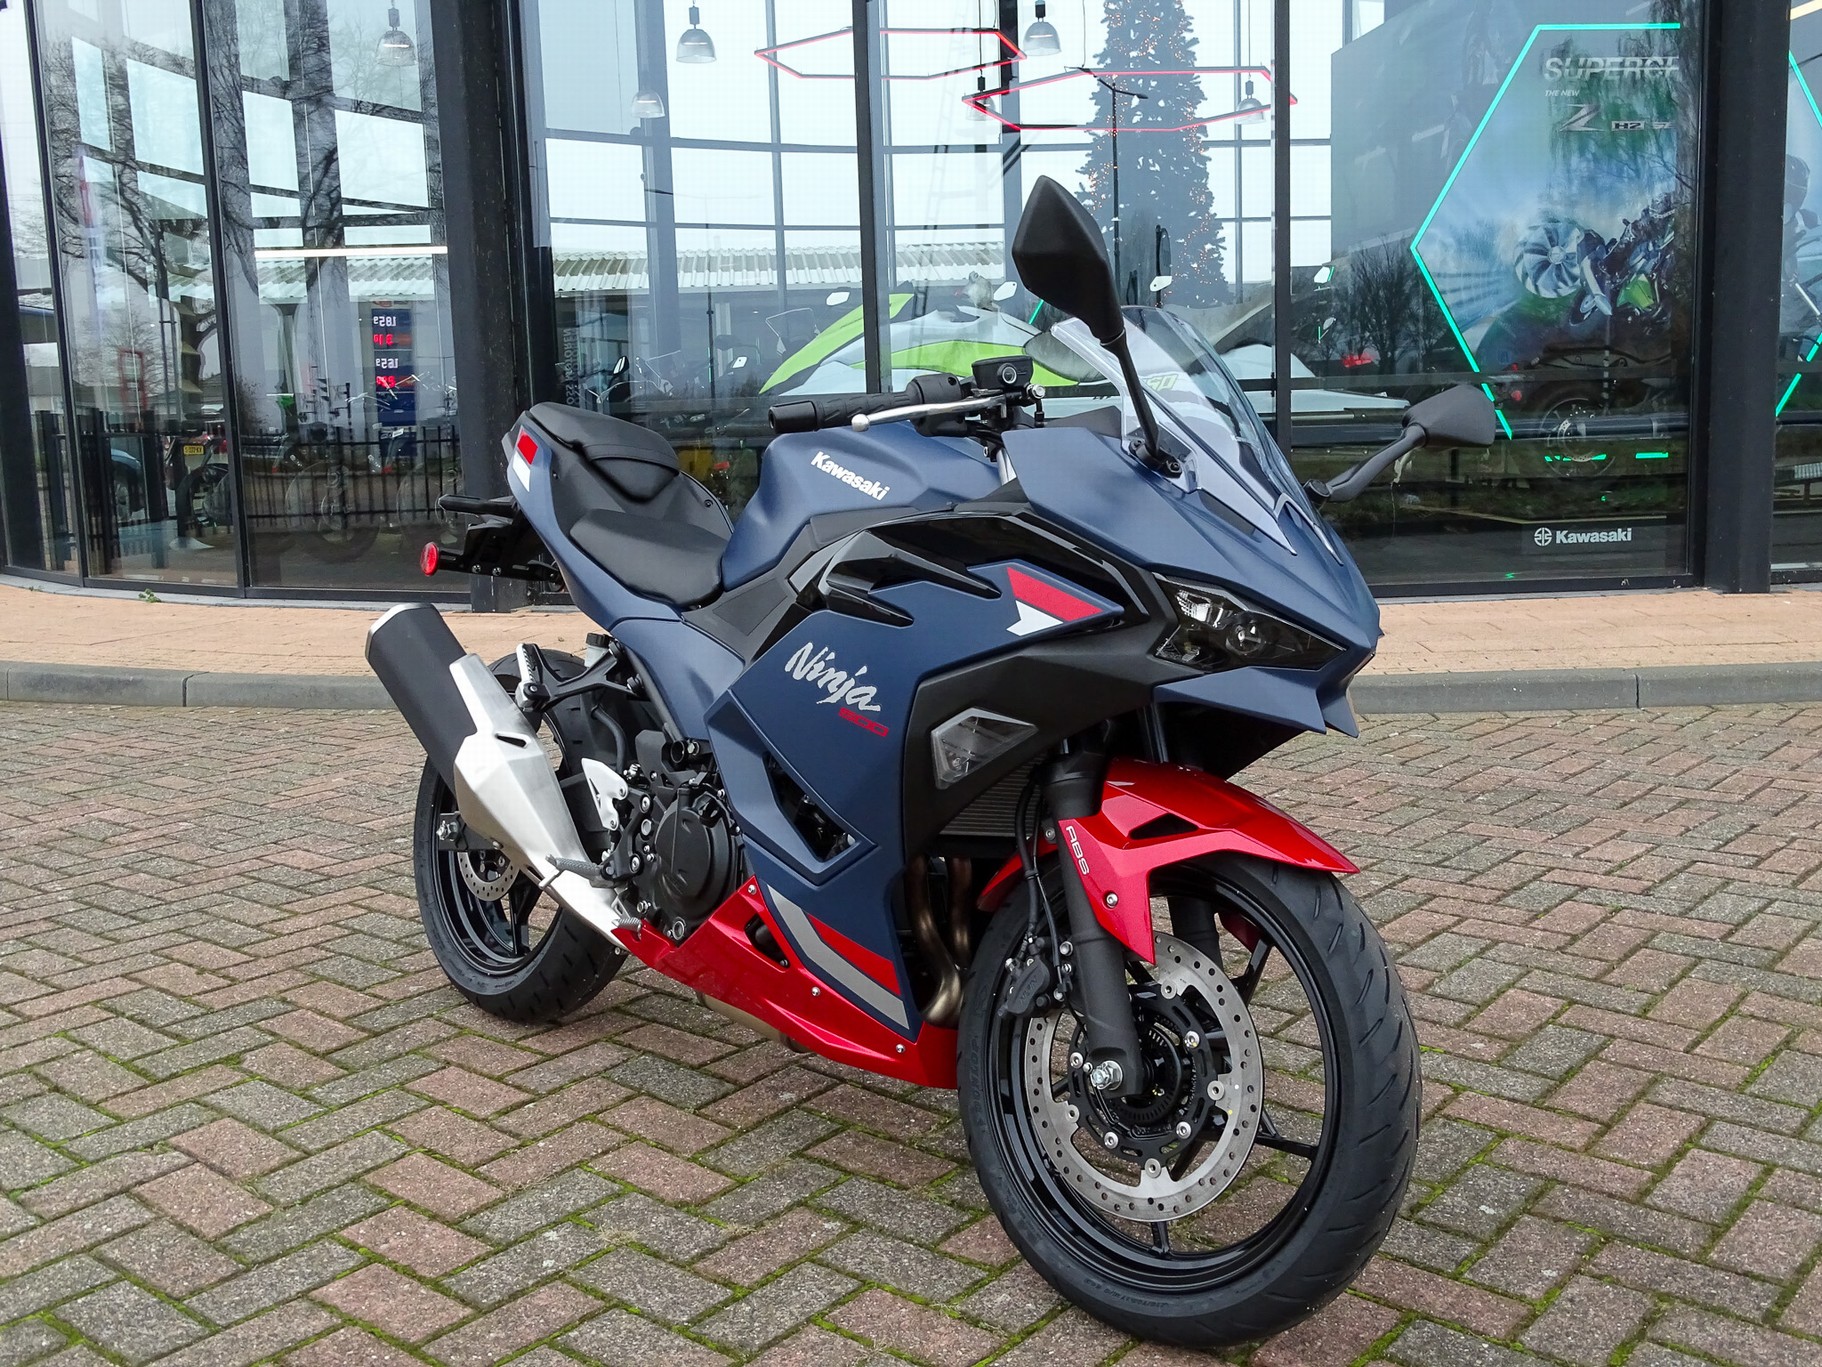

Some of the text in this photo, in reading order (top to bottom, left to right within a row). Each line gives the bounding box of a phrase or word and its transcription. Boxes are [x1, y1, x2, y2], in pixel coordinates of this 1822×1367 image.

[1544, 89, 1580, 97] THE NEW
[810, 451, 891, 502] Kawasaki
[1555, 527, 1633, 545] Kawasaki
[784, 641, 882, 713] Ninja
[1065, 825, 1090, 876] ABS
